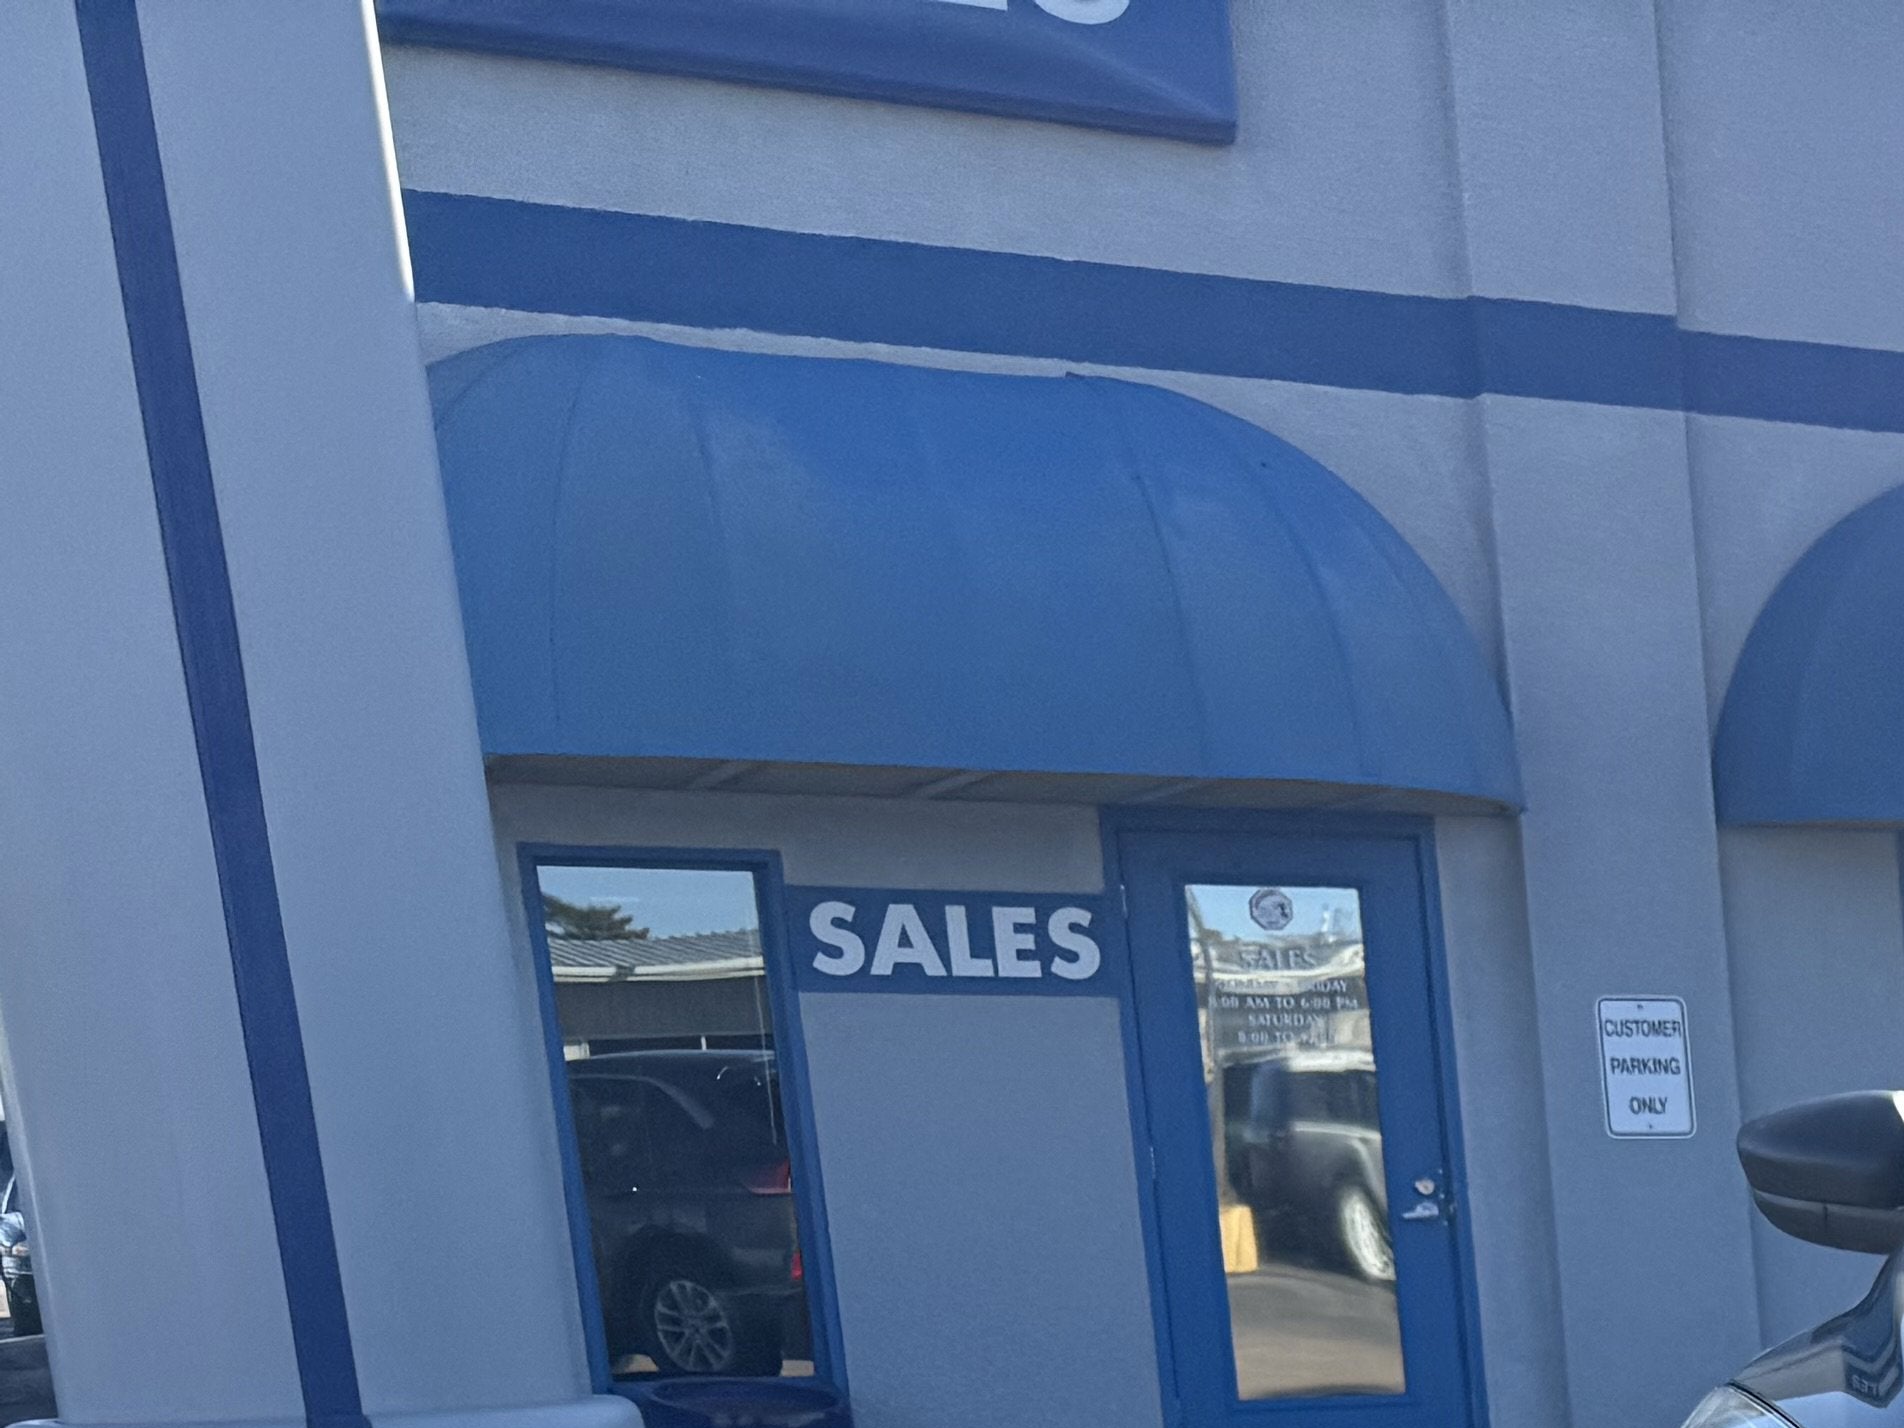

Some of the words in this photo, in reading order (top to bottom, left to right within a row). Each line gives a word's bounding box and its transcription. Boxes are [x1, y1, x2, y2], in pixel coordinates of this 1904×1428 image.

[809, 901, 1100, 980] SALES
[1240, 948, 1318, 970] SALES
[1245, 995, 1270, 1009] AM
[1275, 996, 1295, 1009] TO
[1336, 997, 1359, 1009] PM
[1248, 1013, 1323, 1027] SATURDAY
[1604, 1019, 1682, 1038] CUSTOMER
[1274, 1031, 1294, 1043] TO
[1610, 1057, 1681, 1075] PARKING
[1629, 1096, 1668, 1115] ONLY
